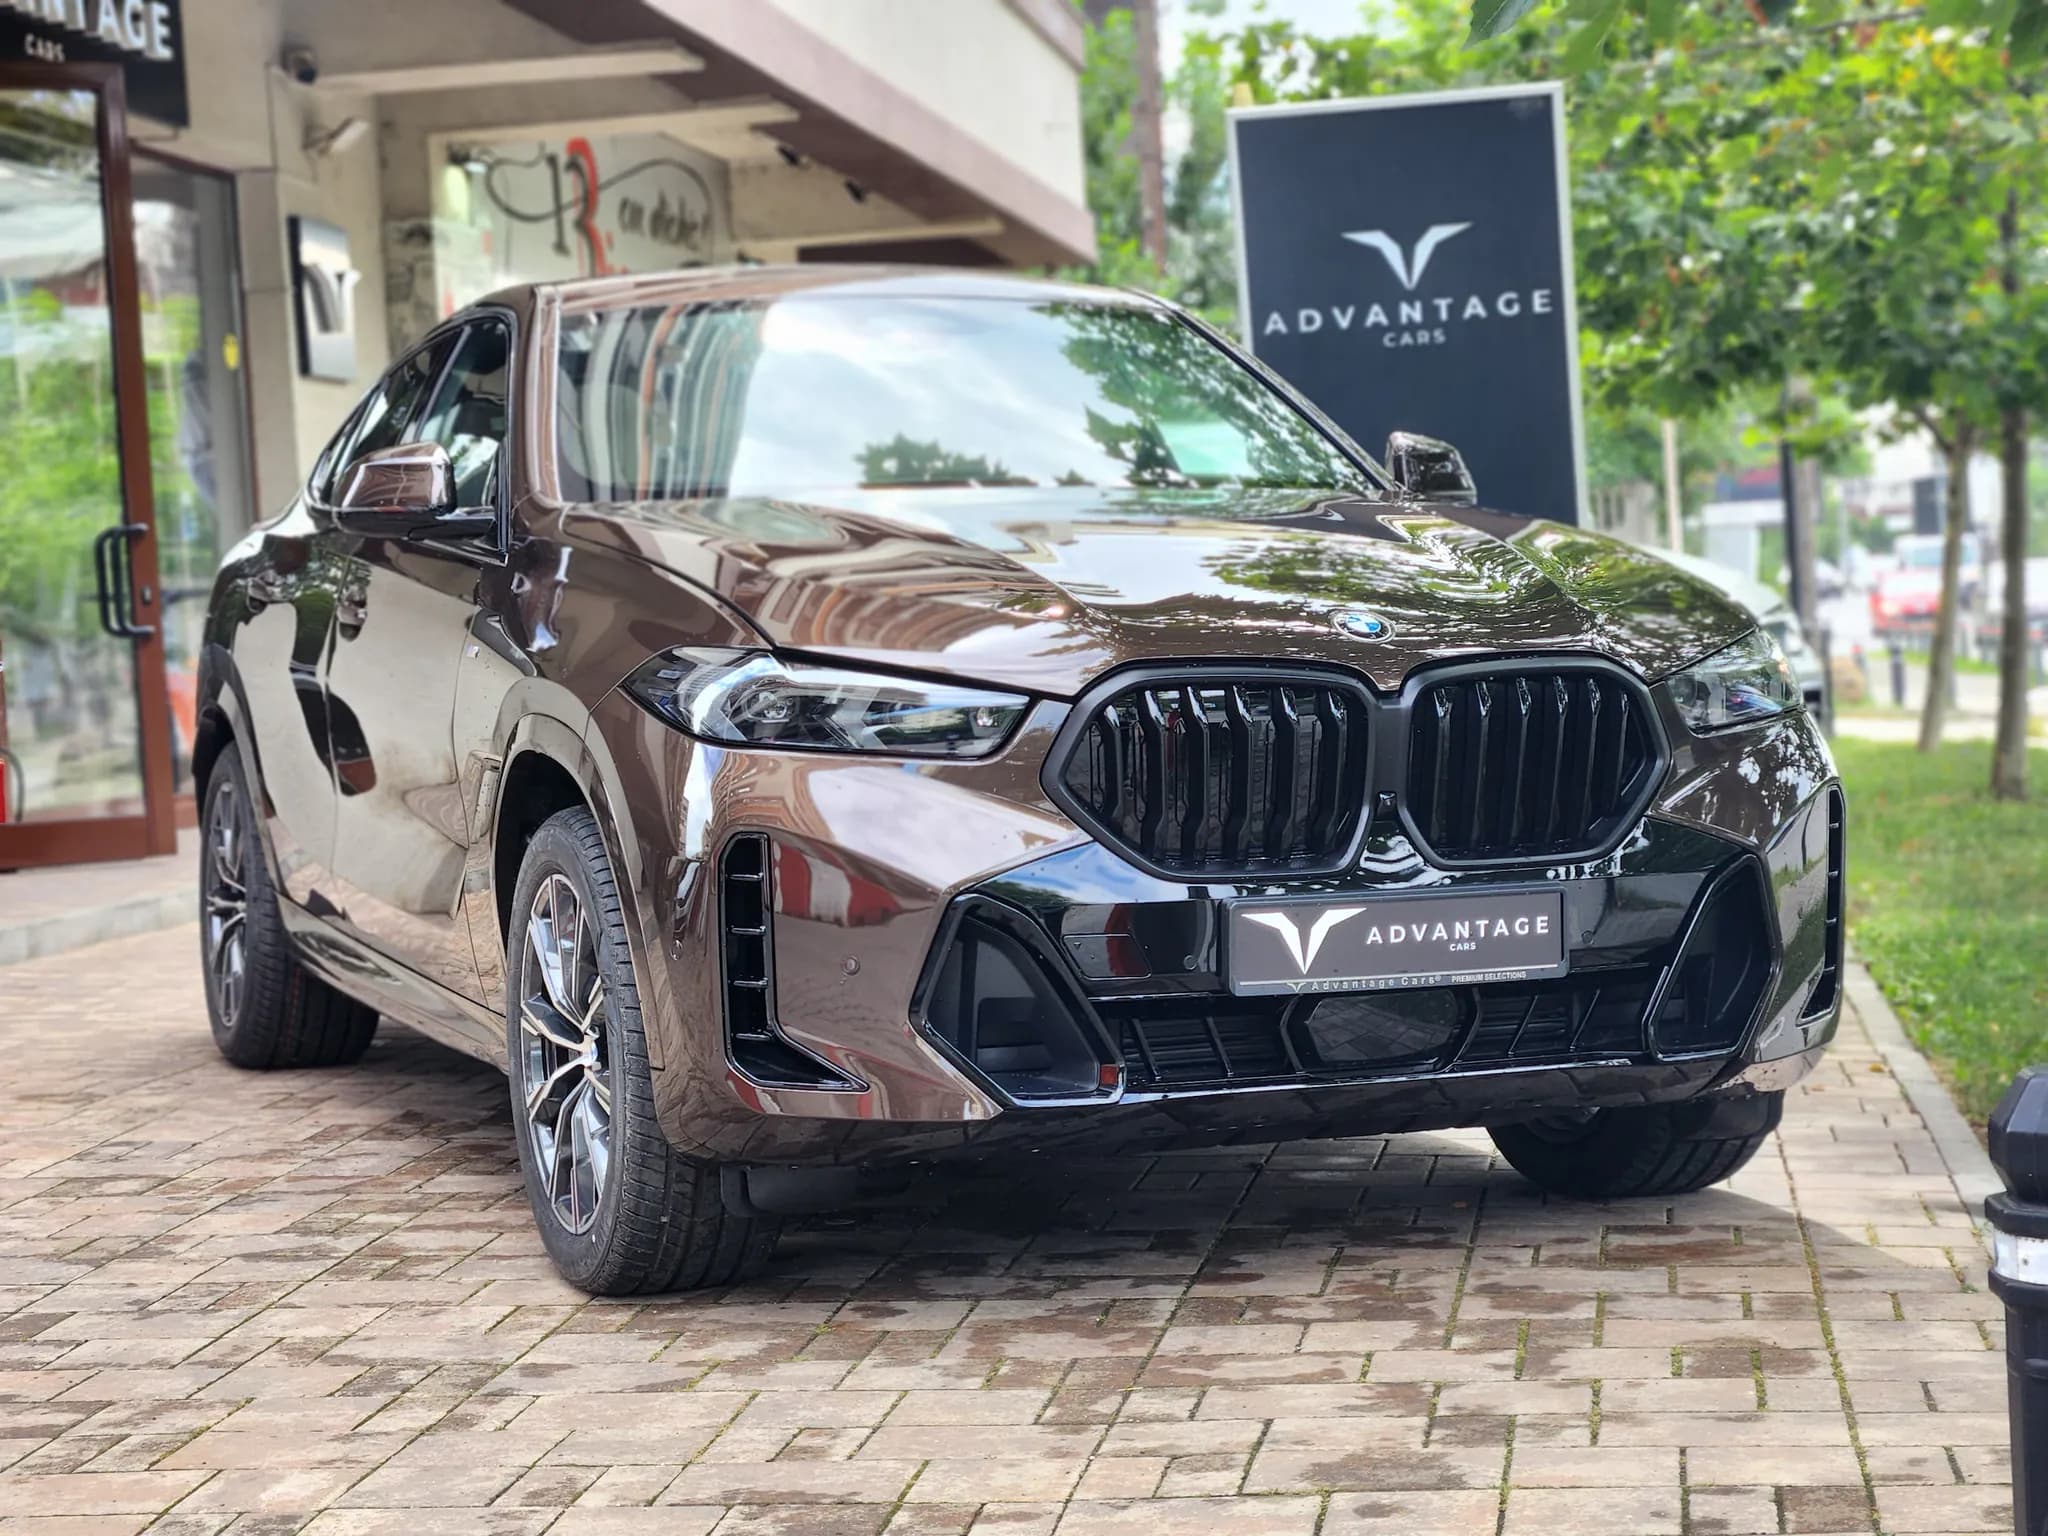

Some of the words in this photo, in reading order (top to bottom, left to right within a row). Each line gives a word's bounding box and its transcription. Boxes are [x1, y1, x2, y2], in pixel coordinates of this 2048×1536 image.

[1263, 289, 1553, 335] ADVANTAGE
[1382, 328, 1446, 348] CARS
[1366, 916, 1550, 945] ADVANTAGE
[1449, 942, 1477, 952] CARS
[1311, 978, 1395, 990] Advantage
[1451, 973, 1483, 983] PREMIUM
[1484, 970, 1527, 981] SELECTIONS
